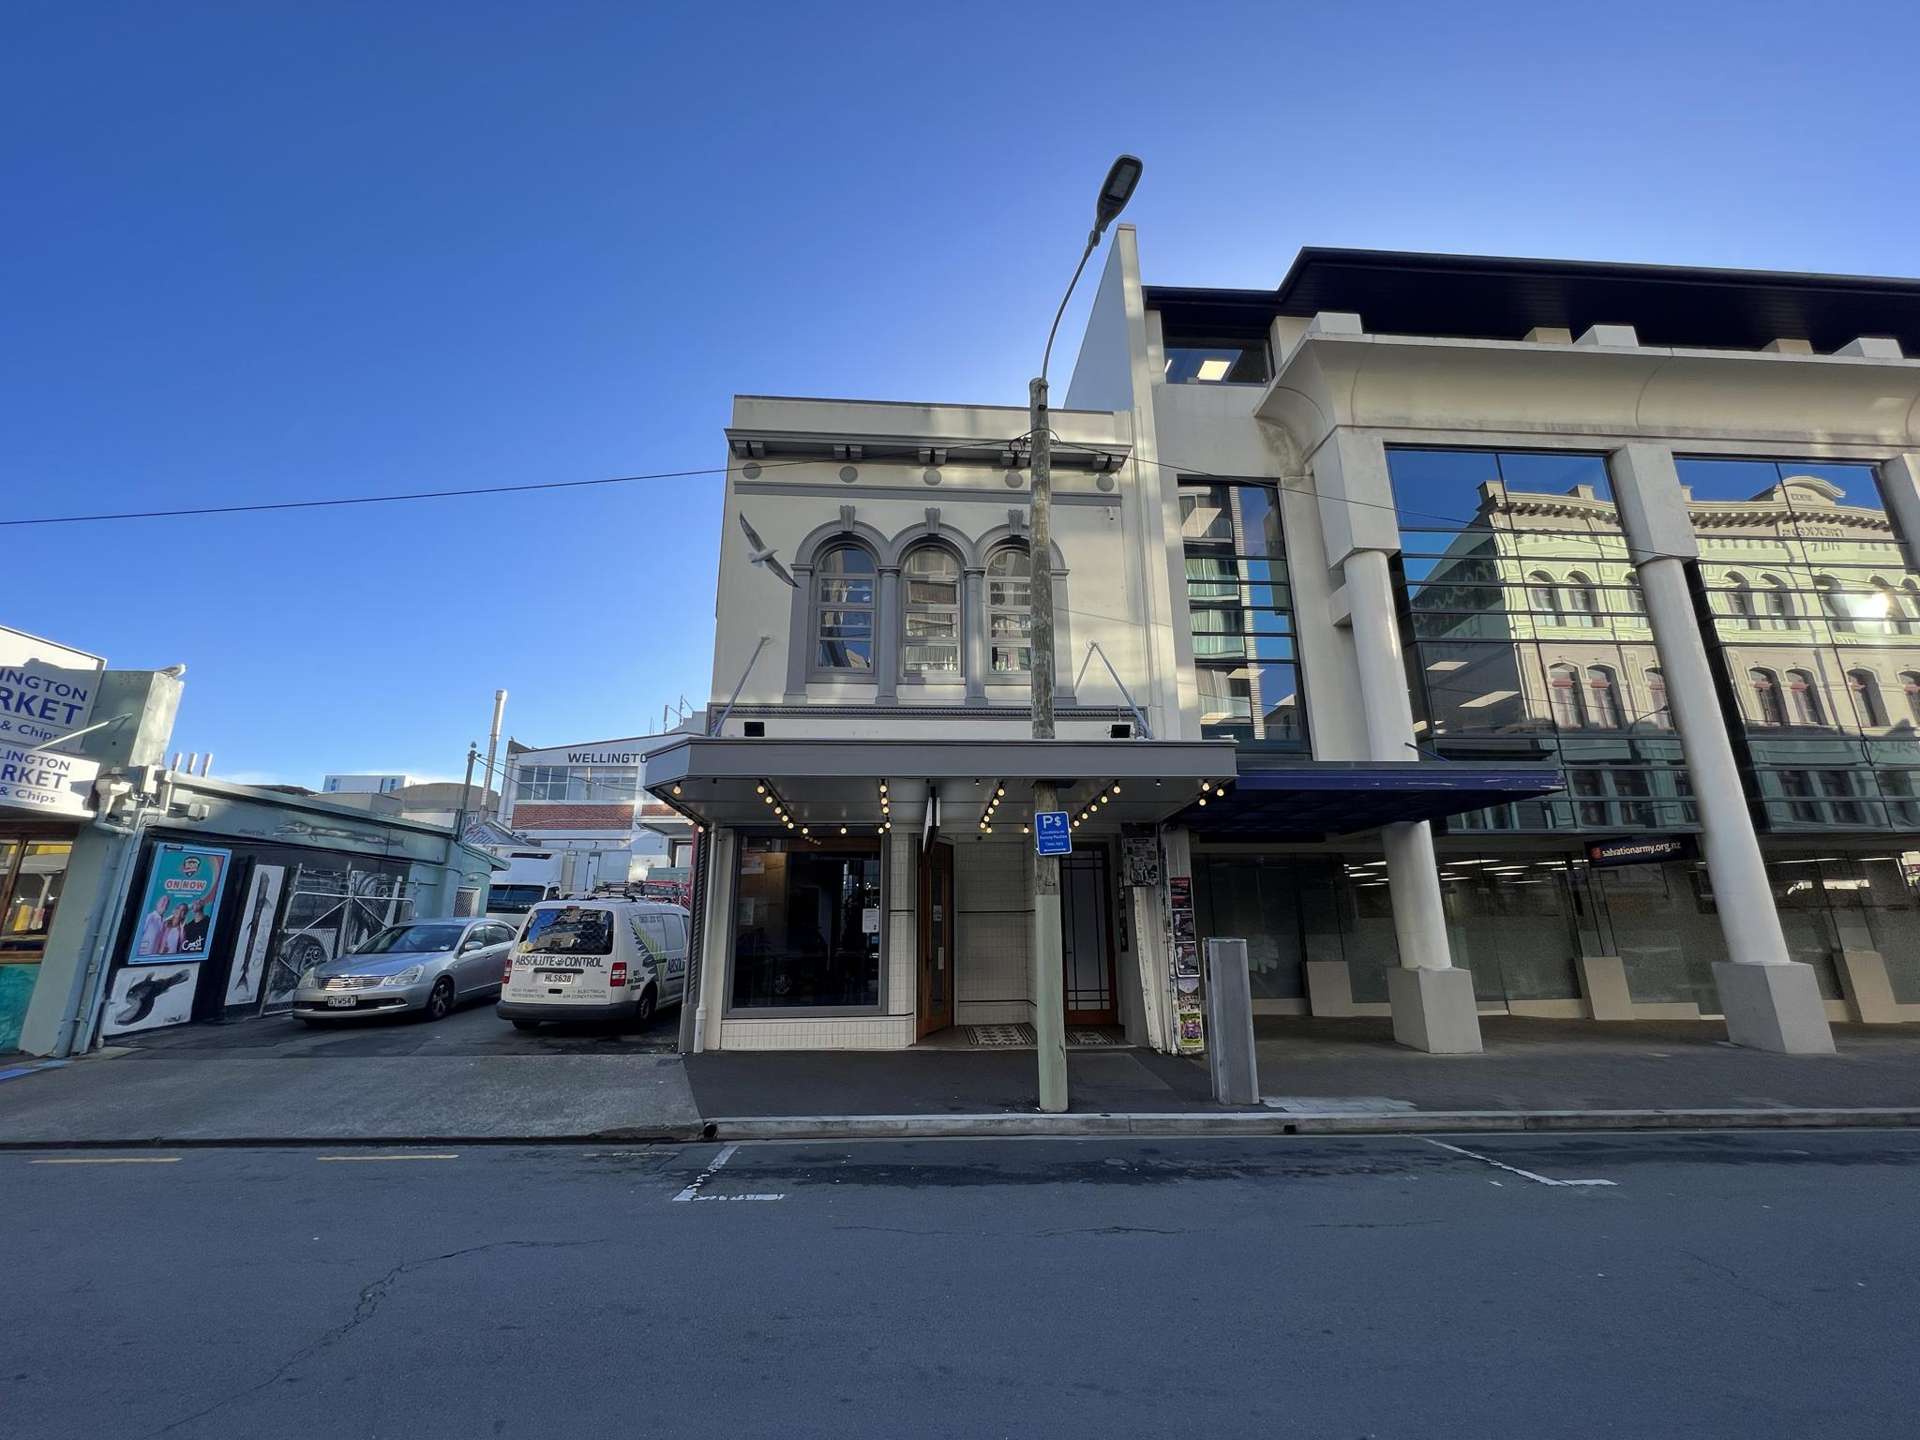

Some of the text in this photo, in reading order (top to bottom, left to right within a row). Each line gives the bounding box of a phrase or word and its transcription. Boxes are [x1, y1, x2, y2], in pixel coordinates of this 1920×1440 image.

[0, 720, 11, 731] &
[1, 763, 68, 789] RKET
[0, 785, 56, 803] & Chips
[1602, 842, 1682, 857] salvationarmy.org.nz
[166, 879, 206, 890] ON NOW
[514, 955, 603, 968] ABSOLUTE CONTROL
